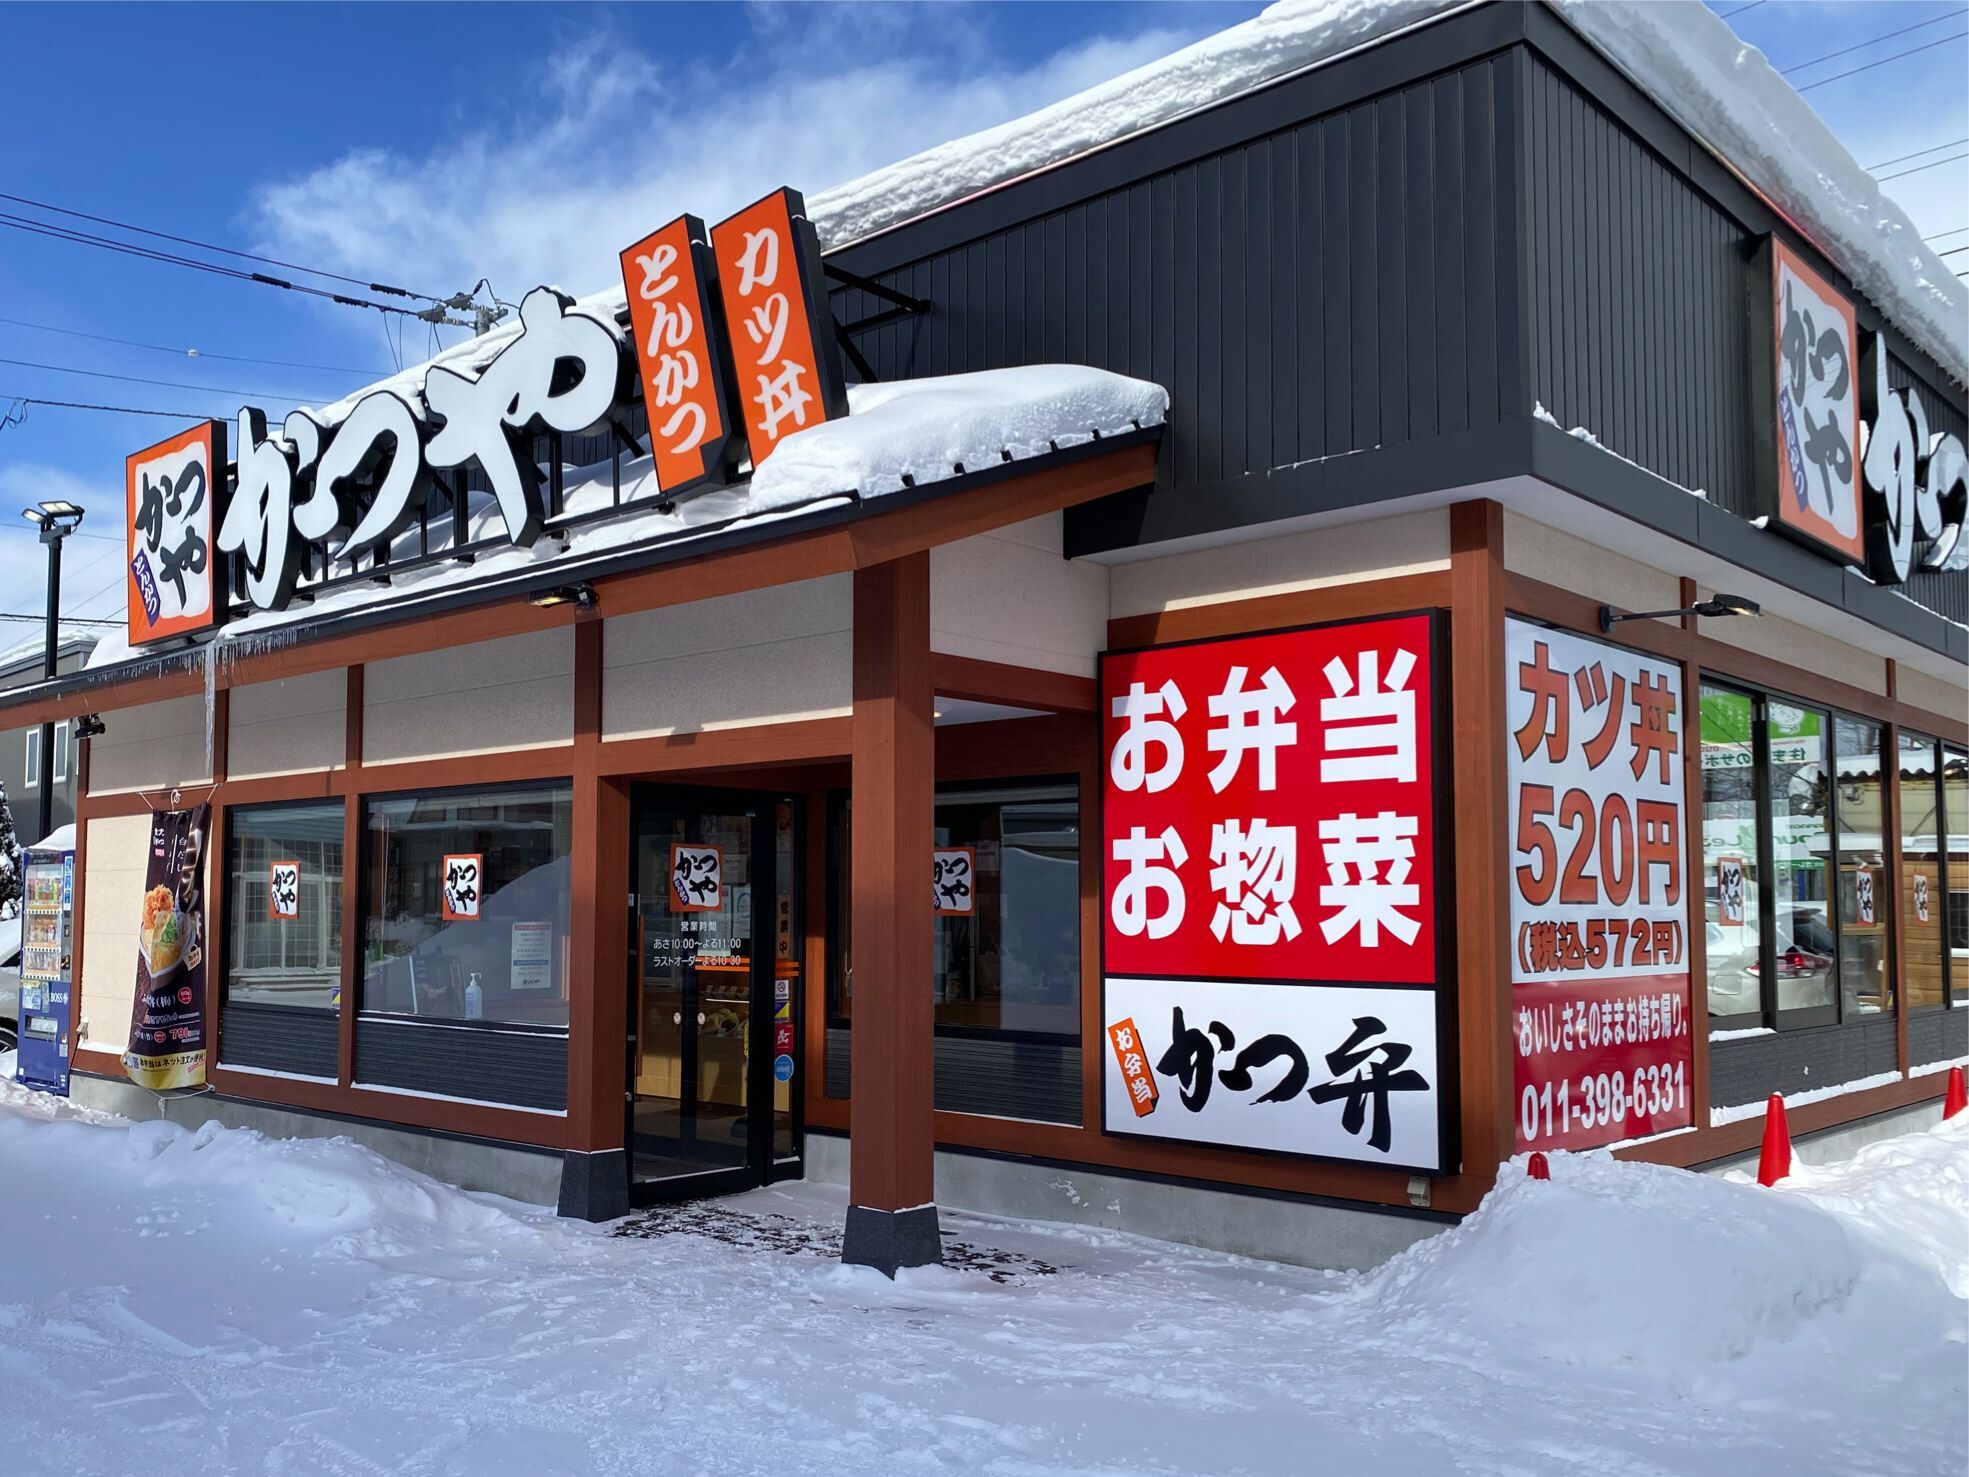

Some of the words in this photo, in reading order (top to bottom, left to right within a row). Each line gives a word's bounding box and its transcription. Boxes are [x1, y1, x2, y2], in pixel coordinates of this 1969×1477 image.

[635, 244, 707, 454] とんかつ
[735, 227, 813, 440] カツ丼
[217, 285, 620, 610] かつや
[134, 460, 207, 610] かつや
[1110, 648, 1418, 793] お弁当
[1514, 640, 1678, 785] カツ丼
[676, 851, 718, 903] かつや
[1111, 811, 1422, 947] お惣菜
[1515, 782, 1680, 906] 520円
[273, 868, 296, 911] かつや
[447, 862, 477, 912] かつや
[681, 921, 717, 932] 営業時間
[653, 955, 740, 967] ラストオーダーよる1030
[1518, 919, 1682, 974] (税込572円)
[50, 992, 63, 1003] BOSS
[1518, 993, 1688, 1058] おいしさそのままお持ち帰り。
[1115, 1027, 1152, 1103] お弁当
[1156, 1006, 1430, 1153] かつ弁
[1522, 1061, 1687, 1142] 011-398-6331
